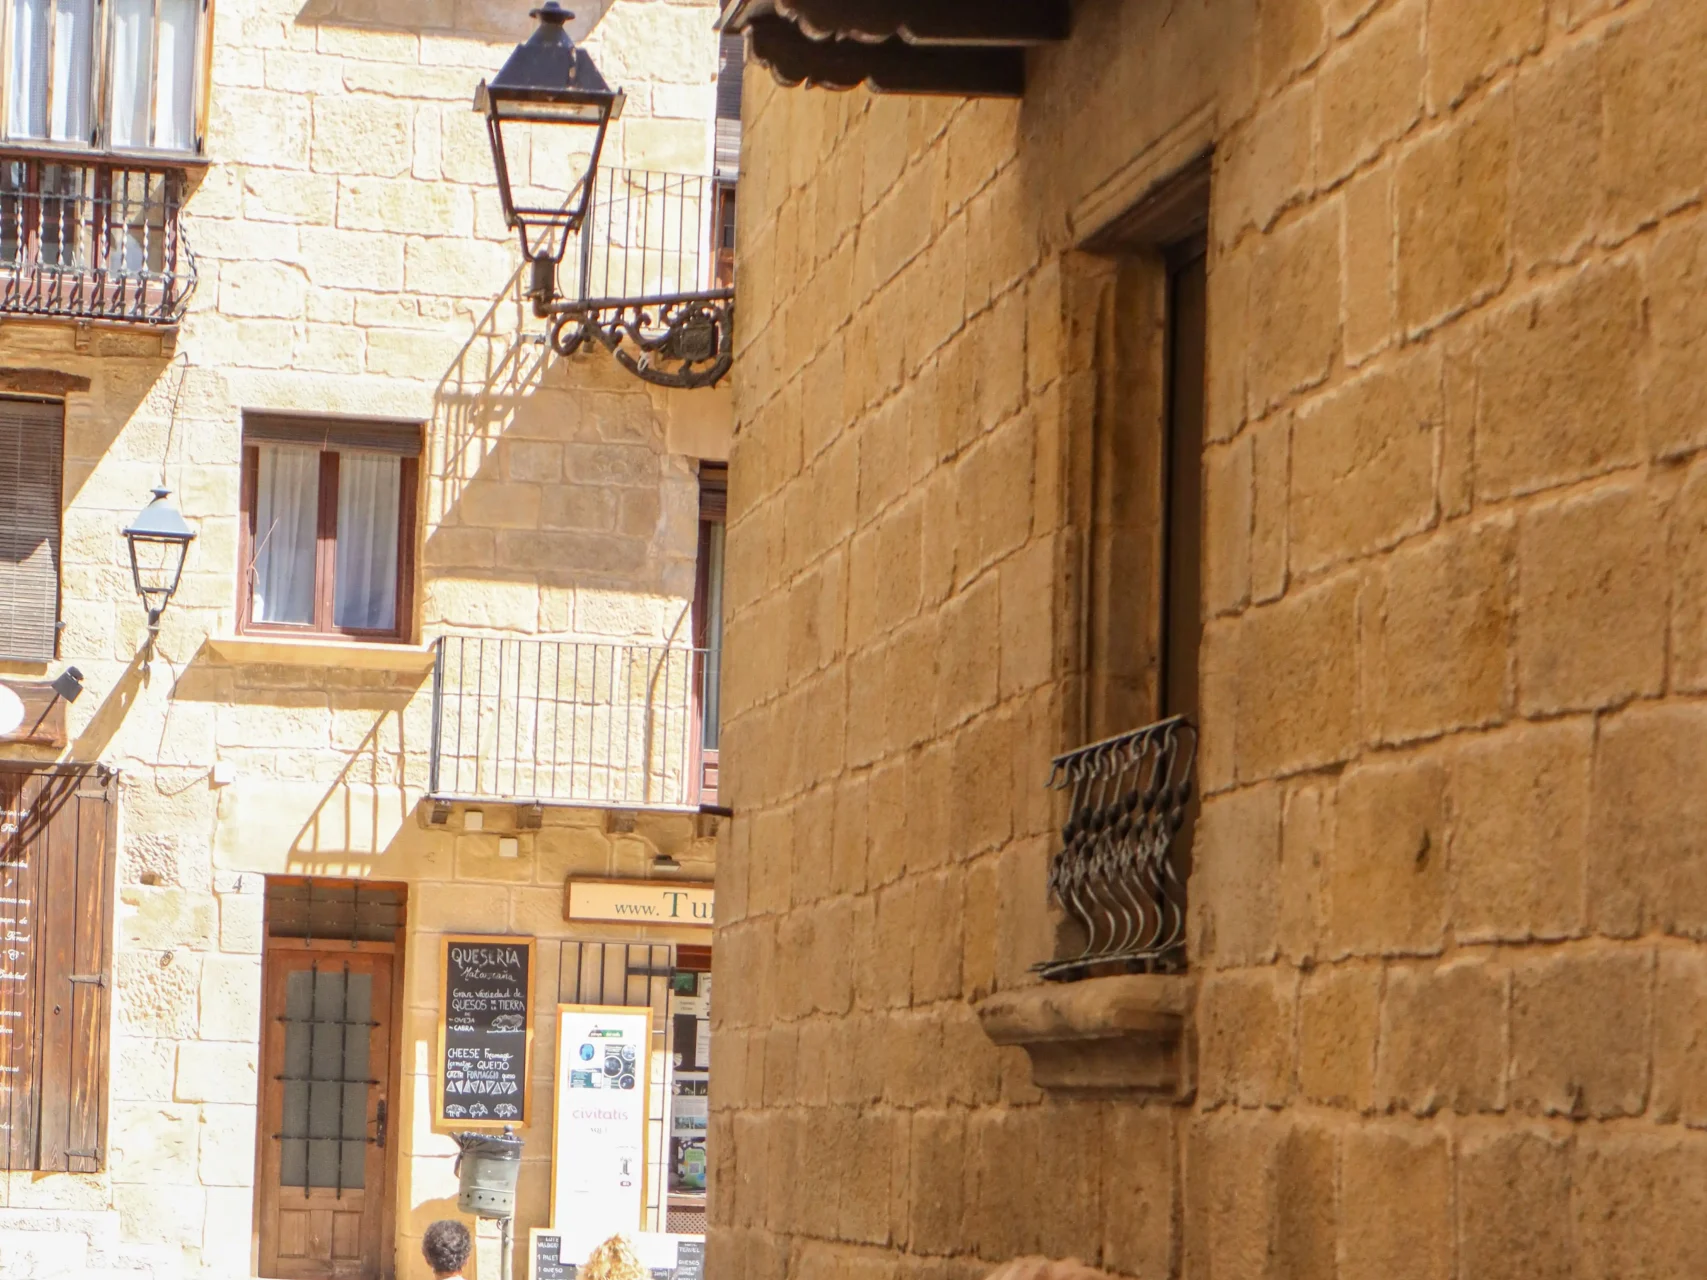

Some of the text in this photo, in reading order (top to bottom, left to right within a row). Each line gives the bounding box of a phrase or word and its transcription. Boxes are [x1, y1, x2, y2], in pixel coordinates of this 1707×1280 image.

[232, 874, 242, 893] 4
[451, 999, 487, 1012] QUESOS
[498, 1000, 525, 1011] TIERRA
[447, 1048, 480, 1059] CHEESE
[477, 1060, 510, 1070] QUEIJO
[572, 1107, 629, 1120] civitatis
